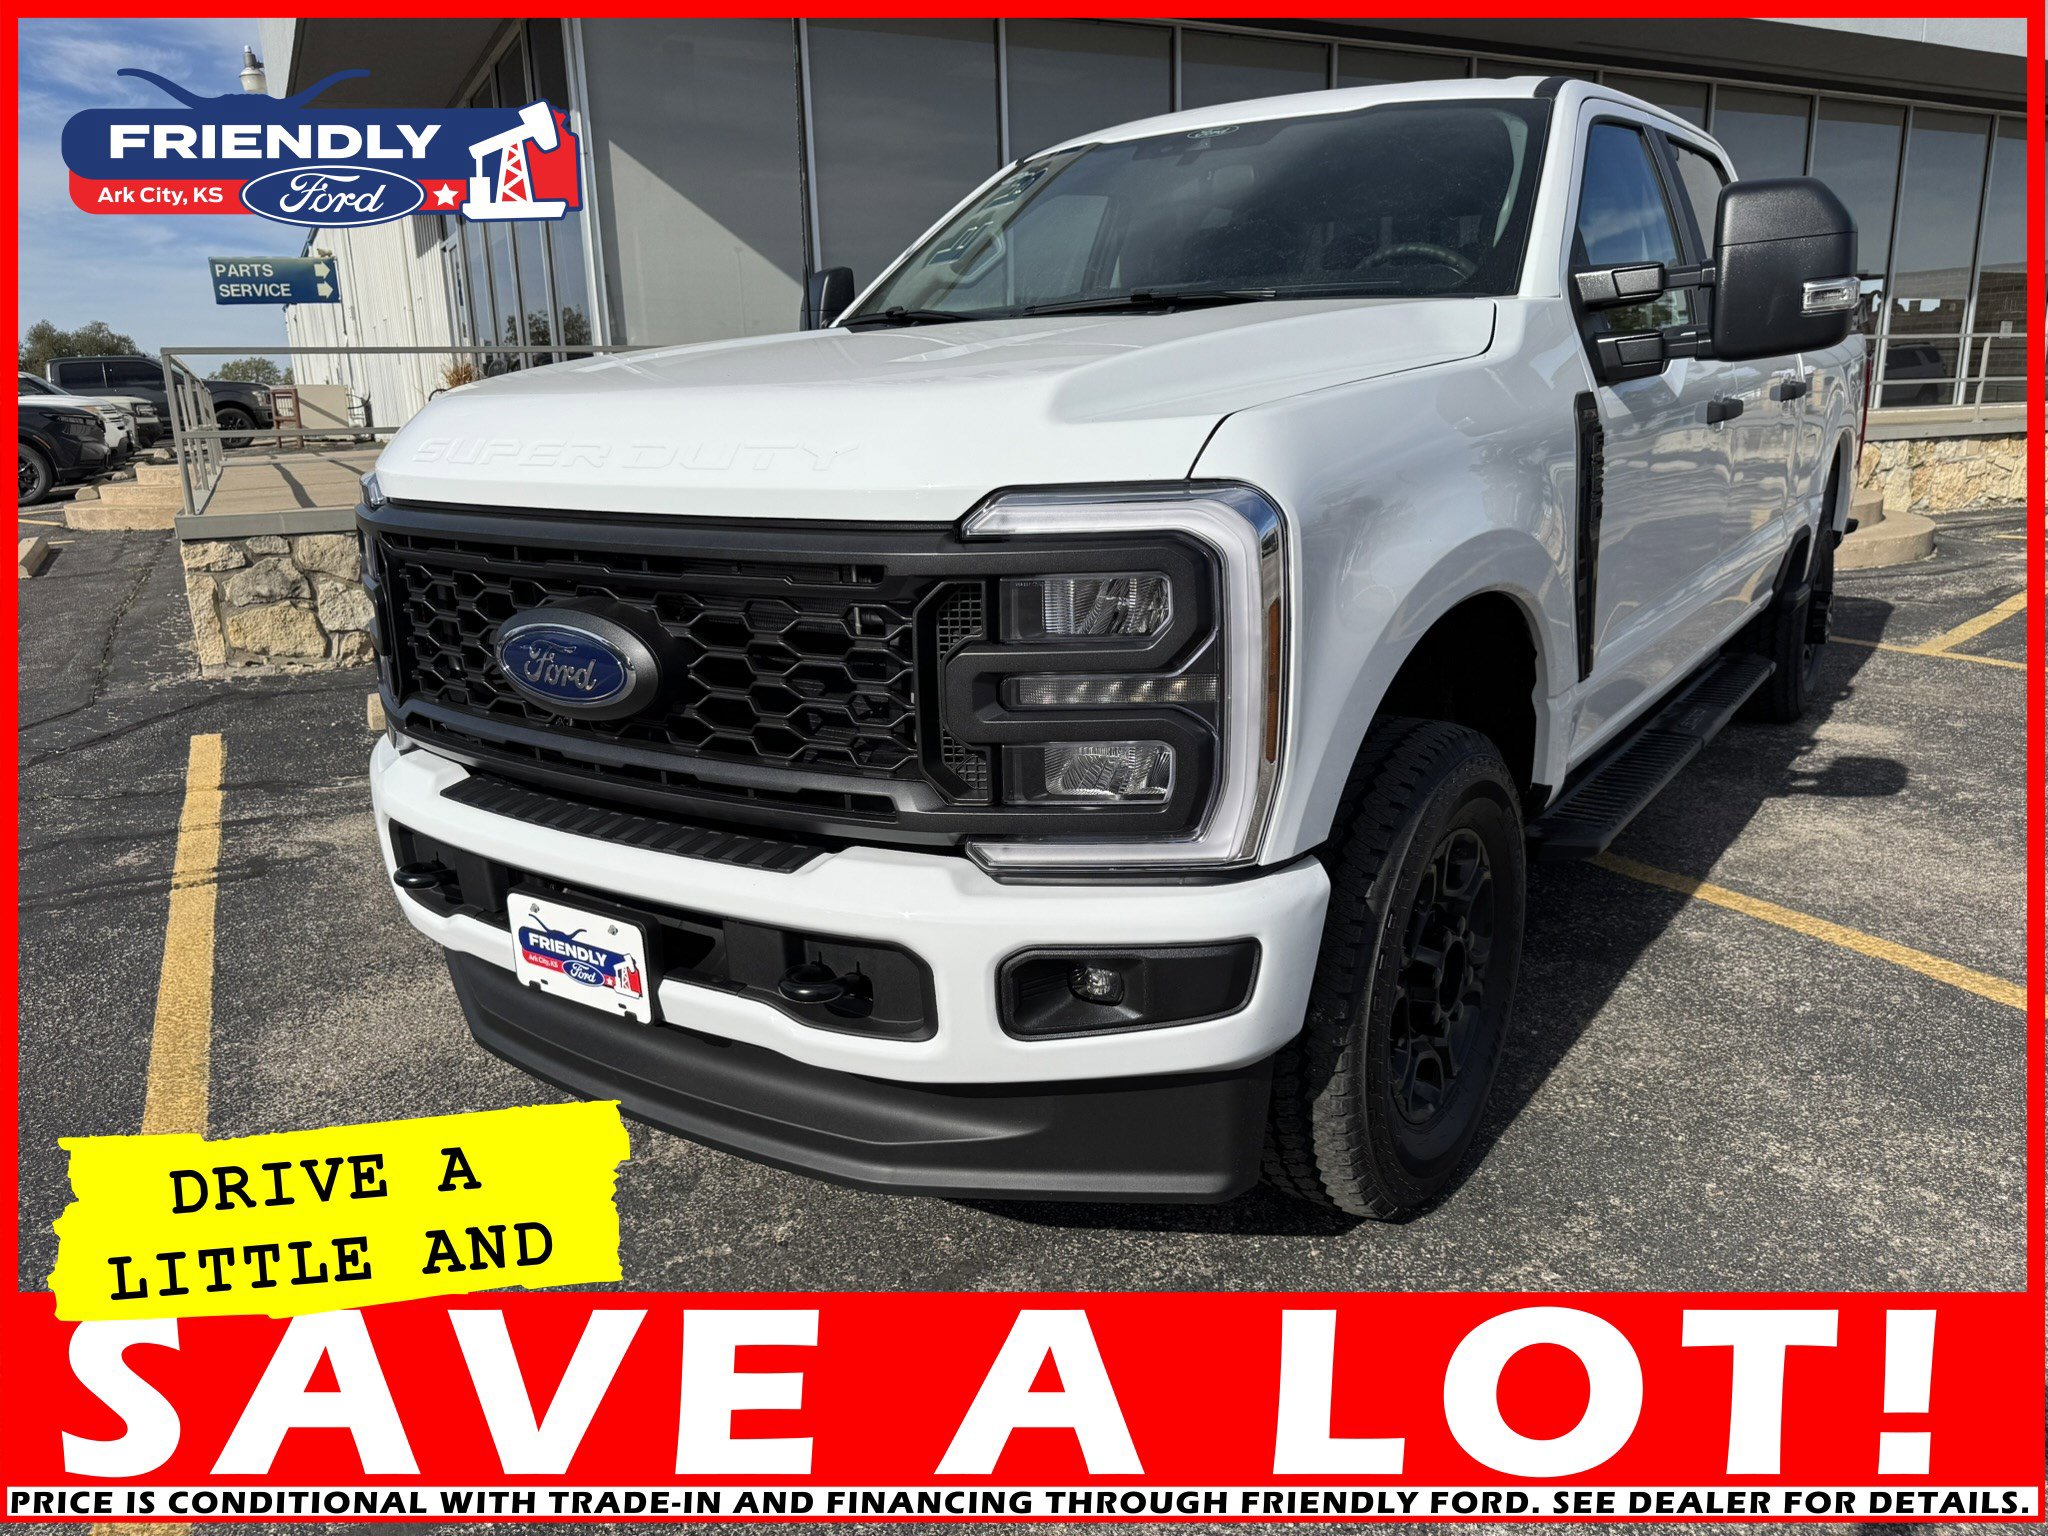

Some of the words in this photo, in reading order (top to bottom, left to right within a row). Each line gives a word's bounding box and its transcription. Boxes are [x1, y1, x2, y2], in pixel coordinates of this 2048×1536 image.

[215, 264, 273, 277] PARTS
[219, 284, 291, 297] SERVICE
[413, 437, 612, 468] SUPER
[622, 441, 860, 471] DUTY
[523, 639, 597, 692] Ford
[529, 933, 607, 967] FRIENDLY
[570, 962, 596, 983] Ford
